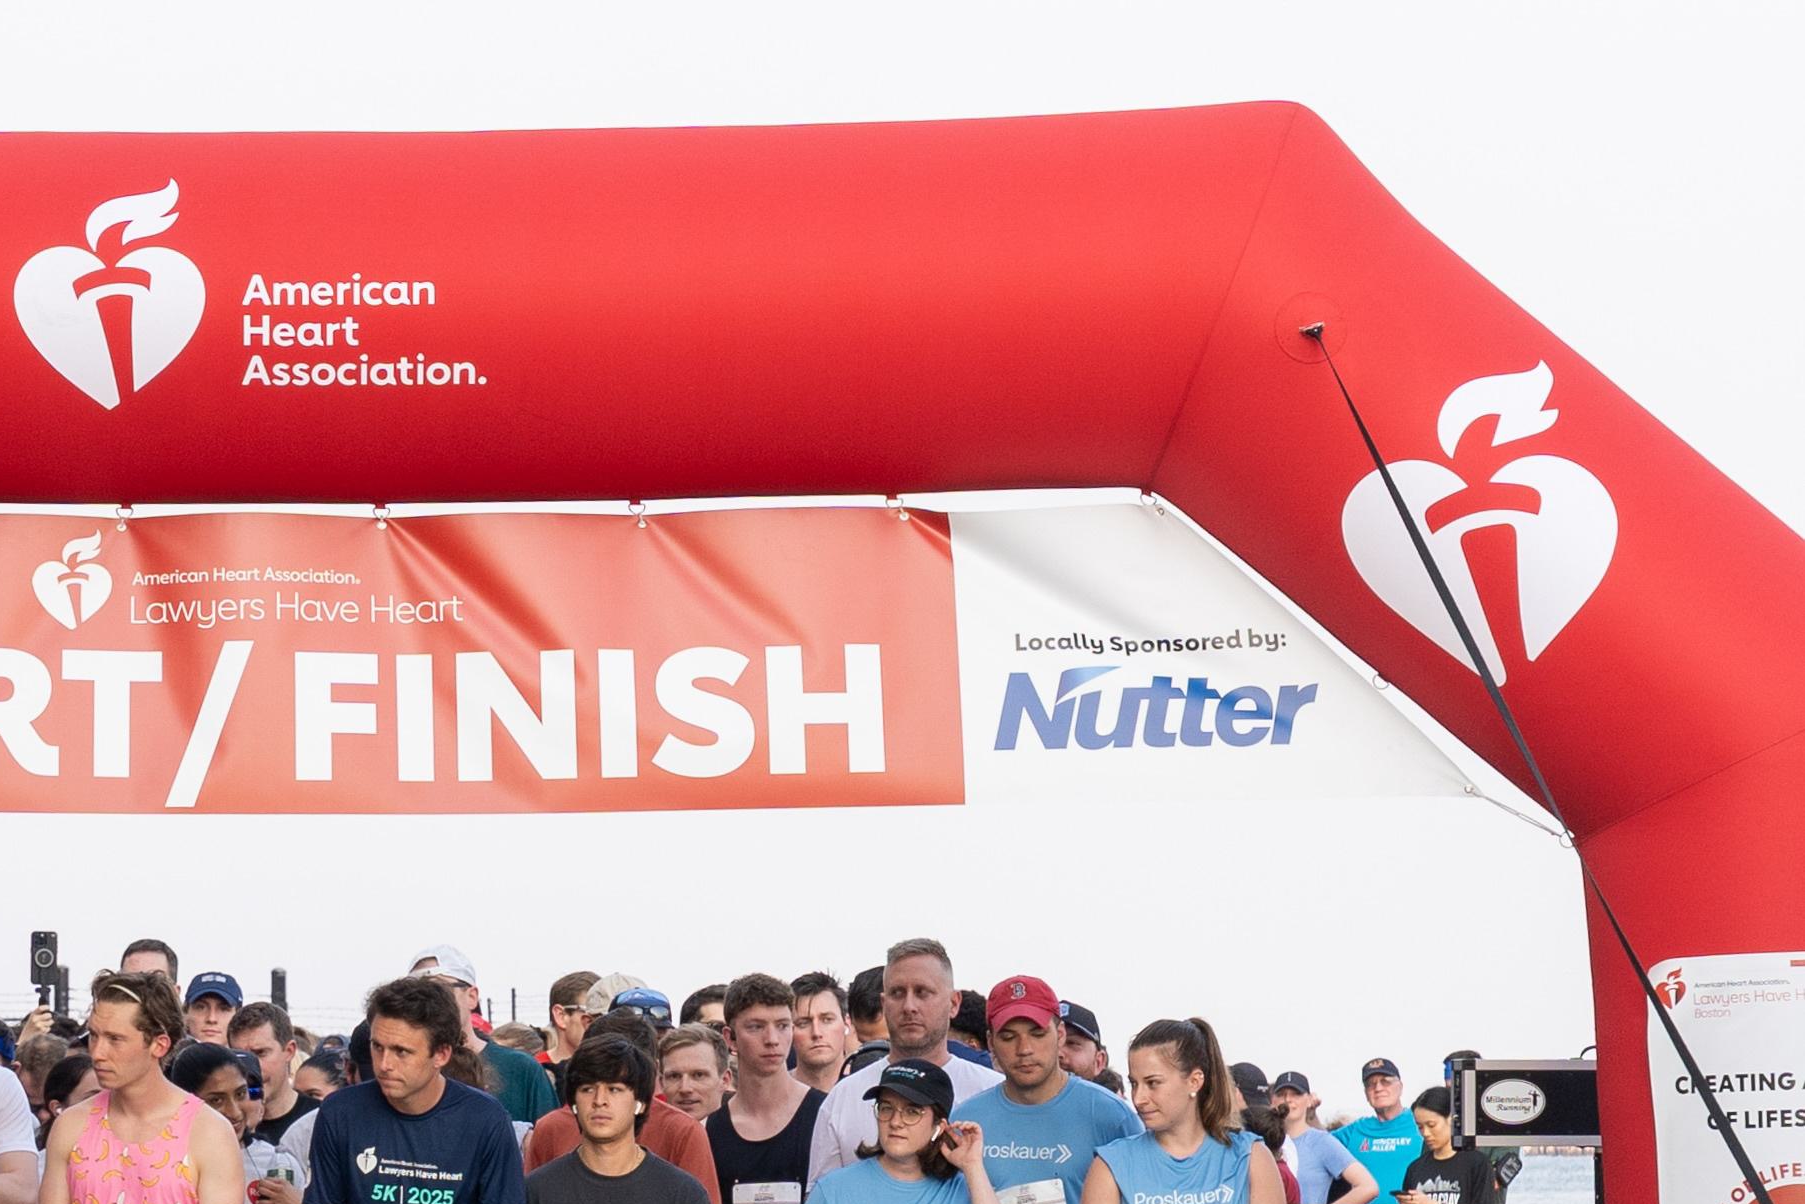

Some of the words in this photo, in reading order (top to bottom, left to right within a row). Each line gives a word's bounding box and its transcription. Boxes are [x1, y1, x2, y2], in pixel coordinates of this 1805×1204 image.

[242, 272, 436, 306] American
[243, 314, 360, 346] Heart
[242, 353, 488, 386] Association.
[132, 570, 209, 586] American
[213, 568, 259, 585] Heart
[263, 567, 362, 584] Association.
[129, 591, 264, 630] Lawyers
[275, 593, 359, 624] Have
[369, 593, 464, 624] Heart
[1014, 633, 1103, 654] Locally
[1110, 629, 1243, 656] Sponsored
[1247, 628, 1287, 651] by:
[294, 643, 886, 783] FINISH
[994, 666, 1319, 751] Nutter
[1694, 992, 1750, 1007] Lawyers
[1754, 990, 1791, 1003] Have
[1695, 1009, 1731, 1019] Boston
[1485, 1095, 1531, 1103] Millennium
[1497, 1104, 1532, 1114] Running
[983, 1141, 1056, 1160] roskauer
[379, 1166, 414, 1178] Lawyers
[416, 1170, 437, 1179] Have
[439, 1172, 463, 1181] Heart
[371, 1184, 397, 1202] 5K
